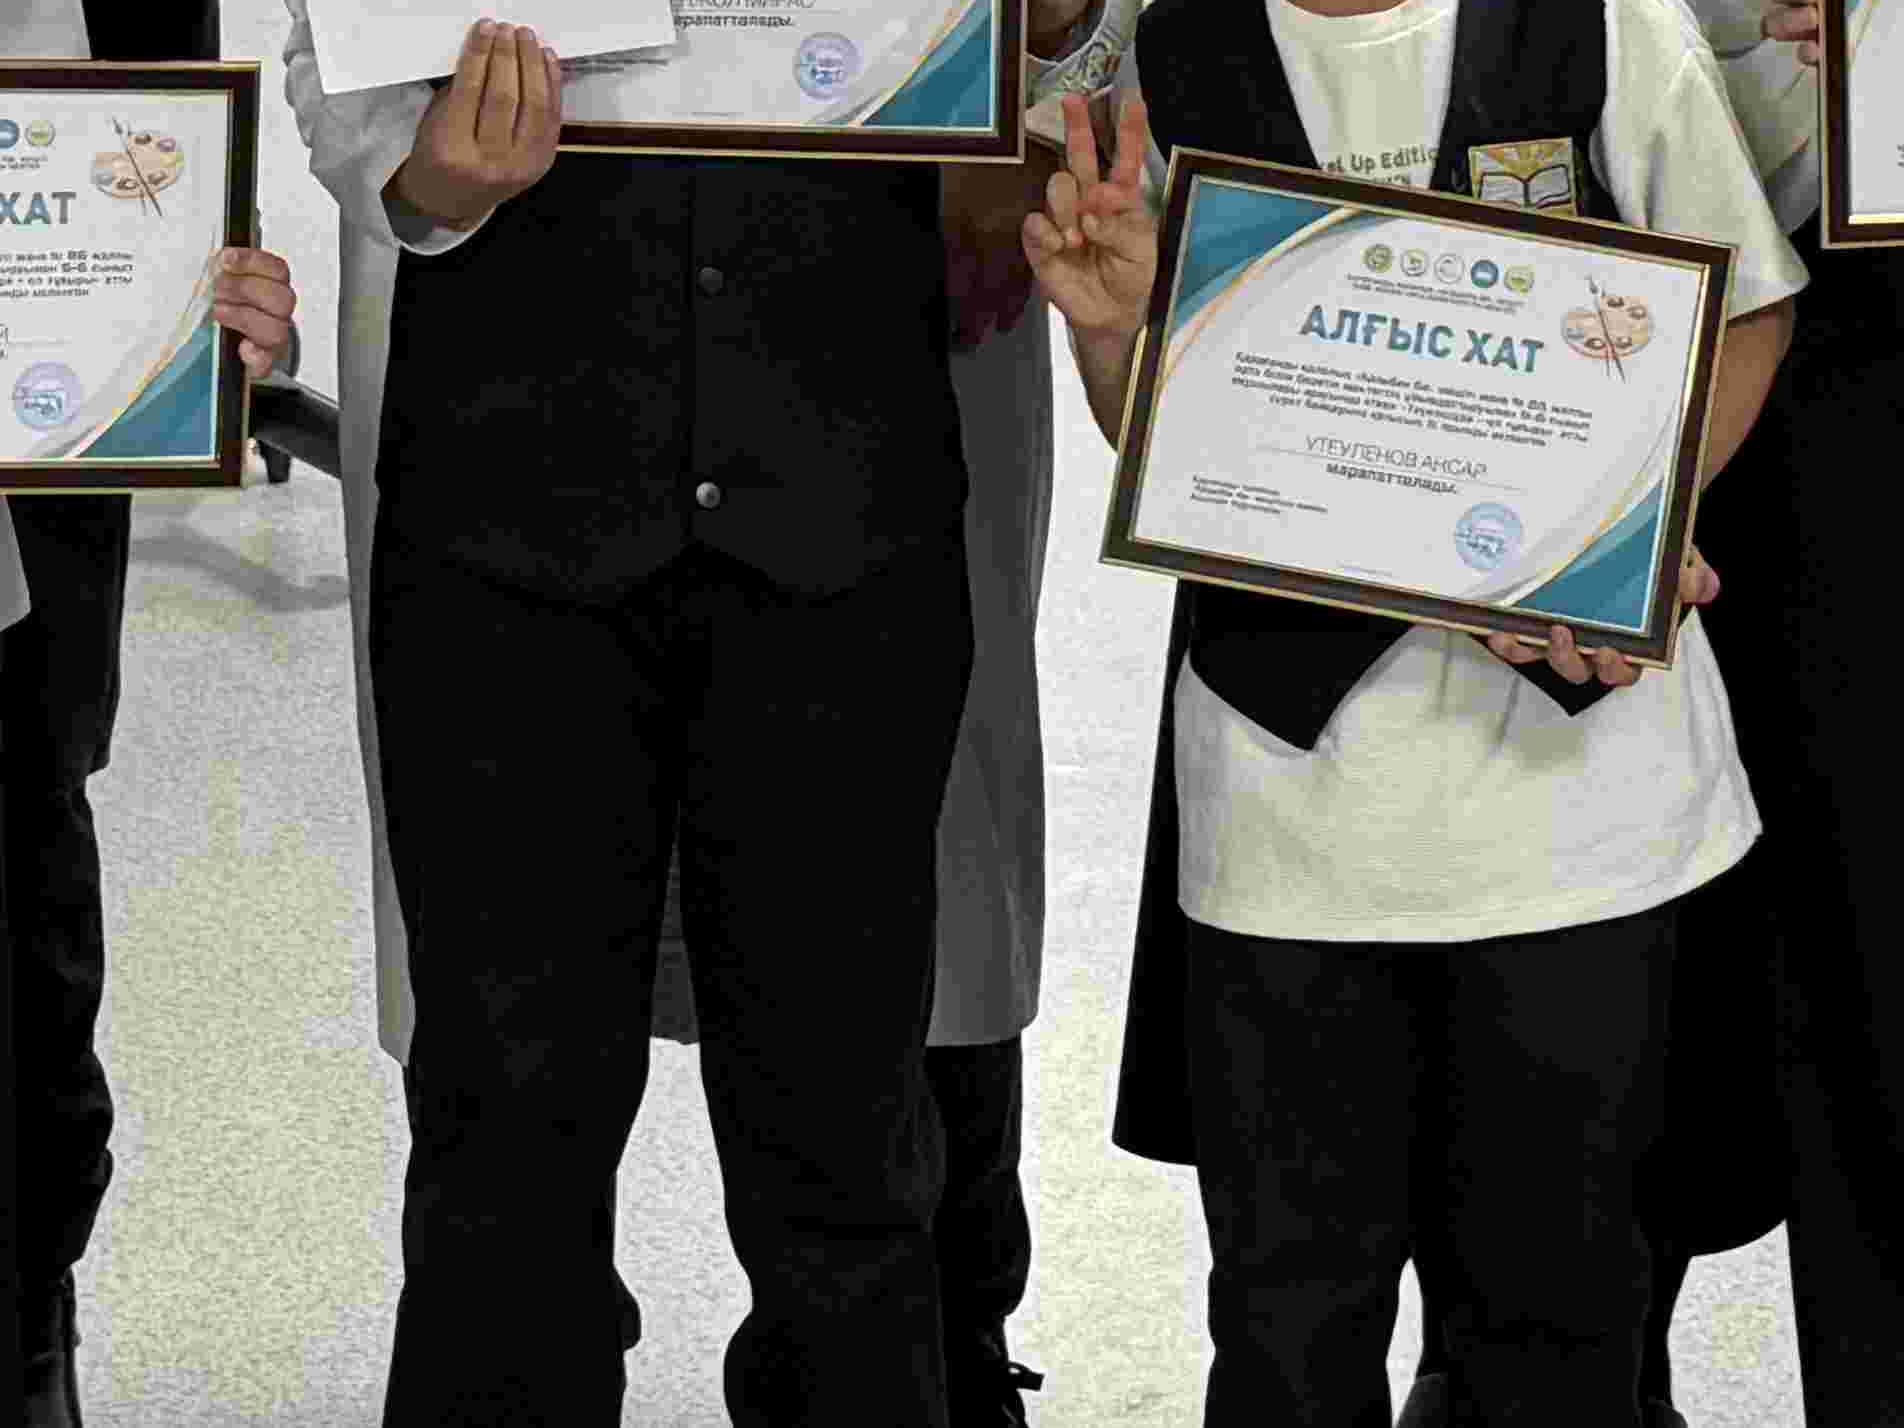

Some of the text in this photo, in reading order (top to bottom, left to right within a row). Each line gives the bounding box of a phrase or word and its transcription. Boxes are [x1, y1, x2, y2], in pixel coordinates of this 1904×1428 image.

[1351, 151, 1377, 173] Up
[1380, 145, 1439, 169] Editio
[1299, 300, 1545, 375] АЛҒЫС ХАТ
